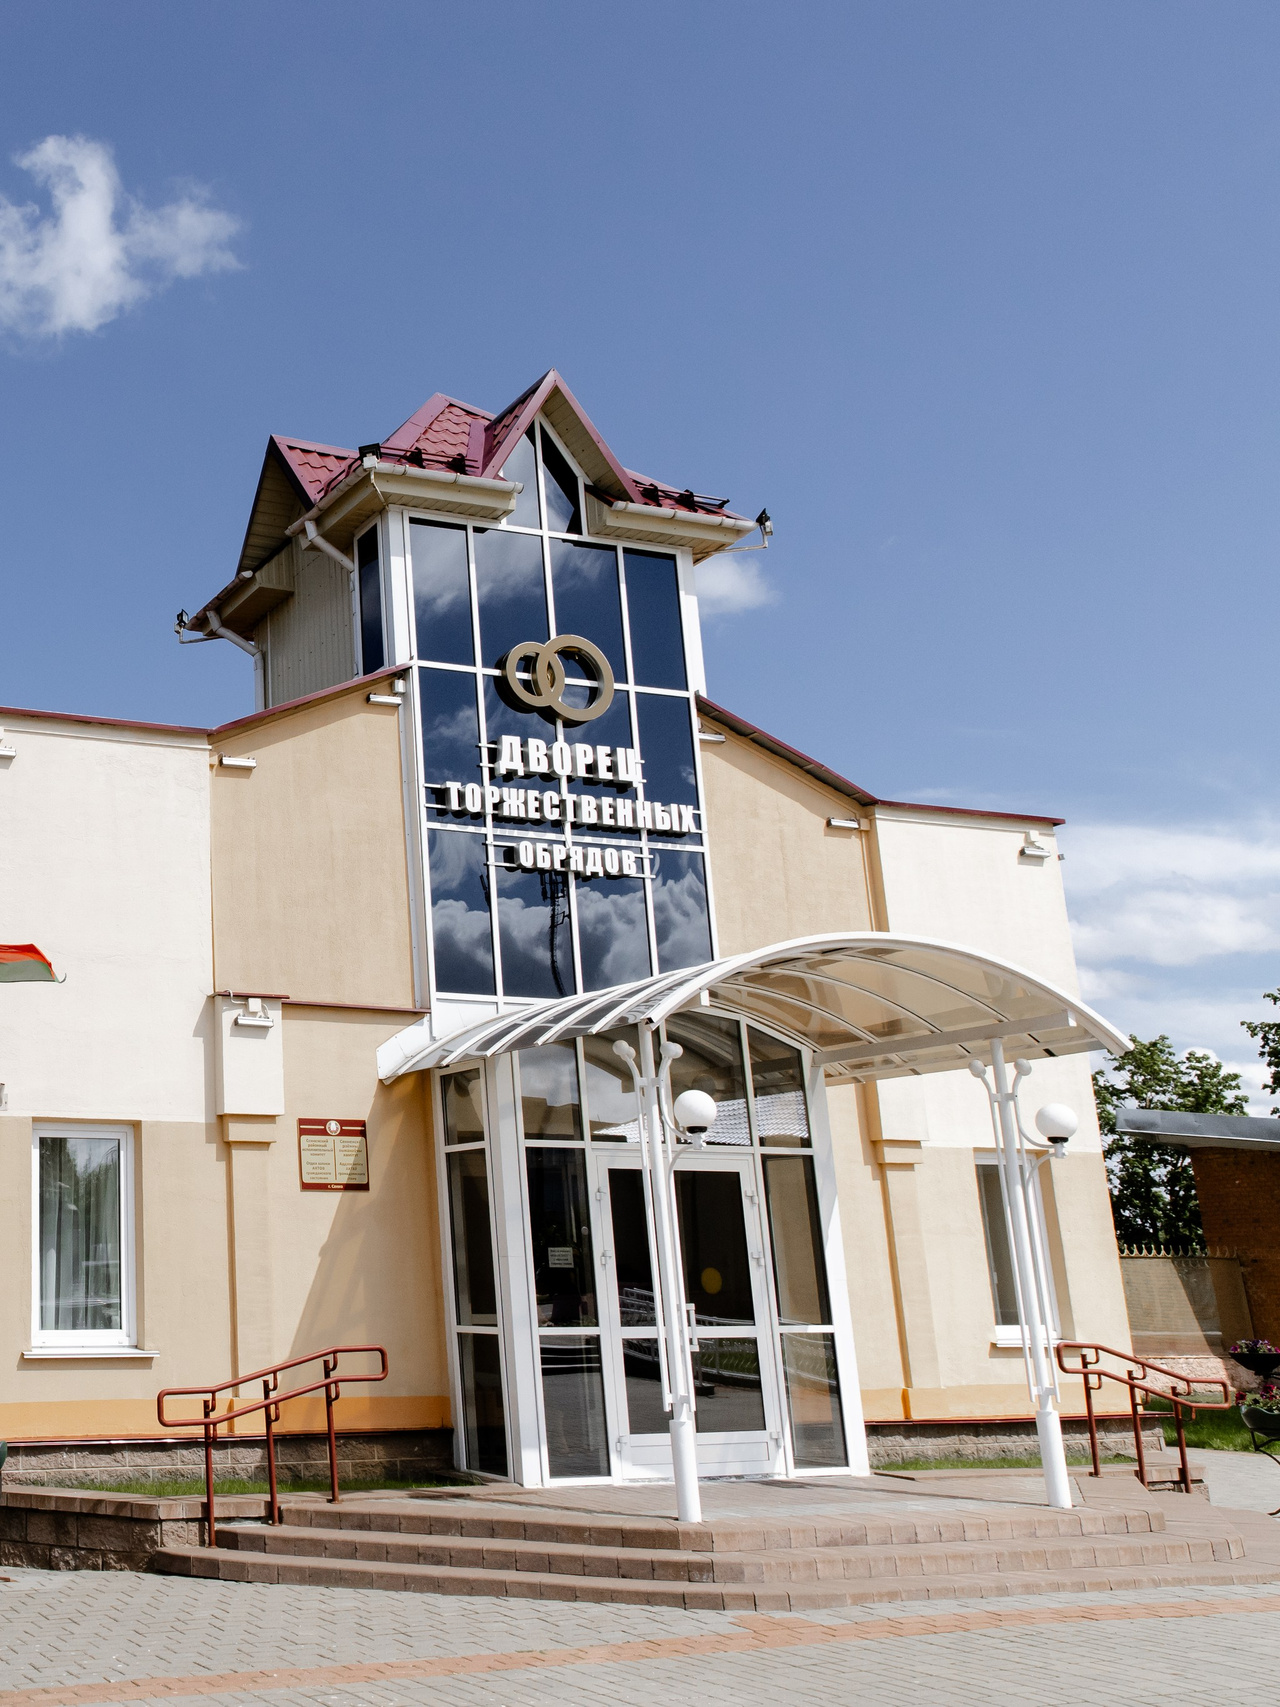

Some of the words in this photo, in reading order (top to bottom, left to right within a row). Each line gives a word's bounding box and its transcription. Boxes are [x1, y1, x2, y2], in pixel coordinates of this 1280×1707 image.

[496, 734, 640, 788] ДВОРЕЦ
[444, 781, 697, 833] ТОРЖЕСТВЕННЫХ
[517, 840, 637, 877] ОБРЯДОВ
